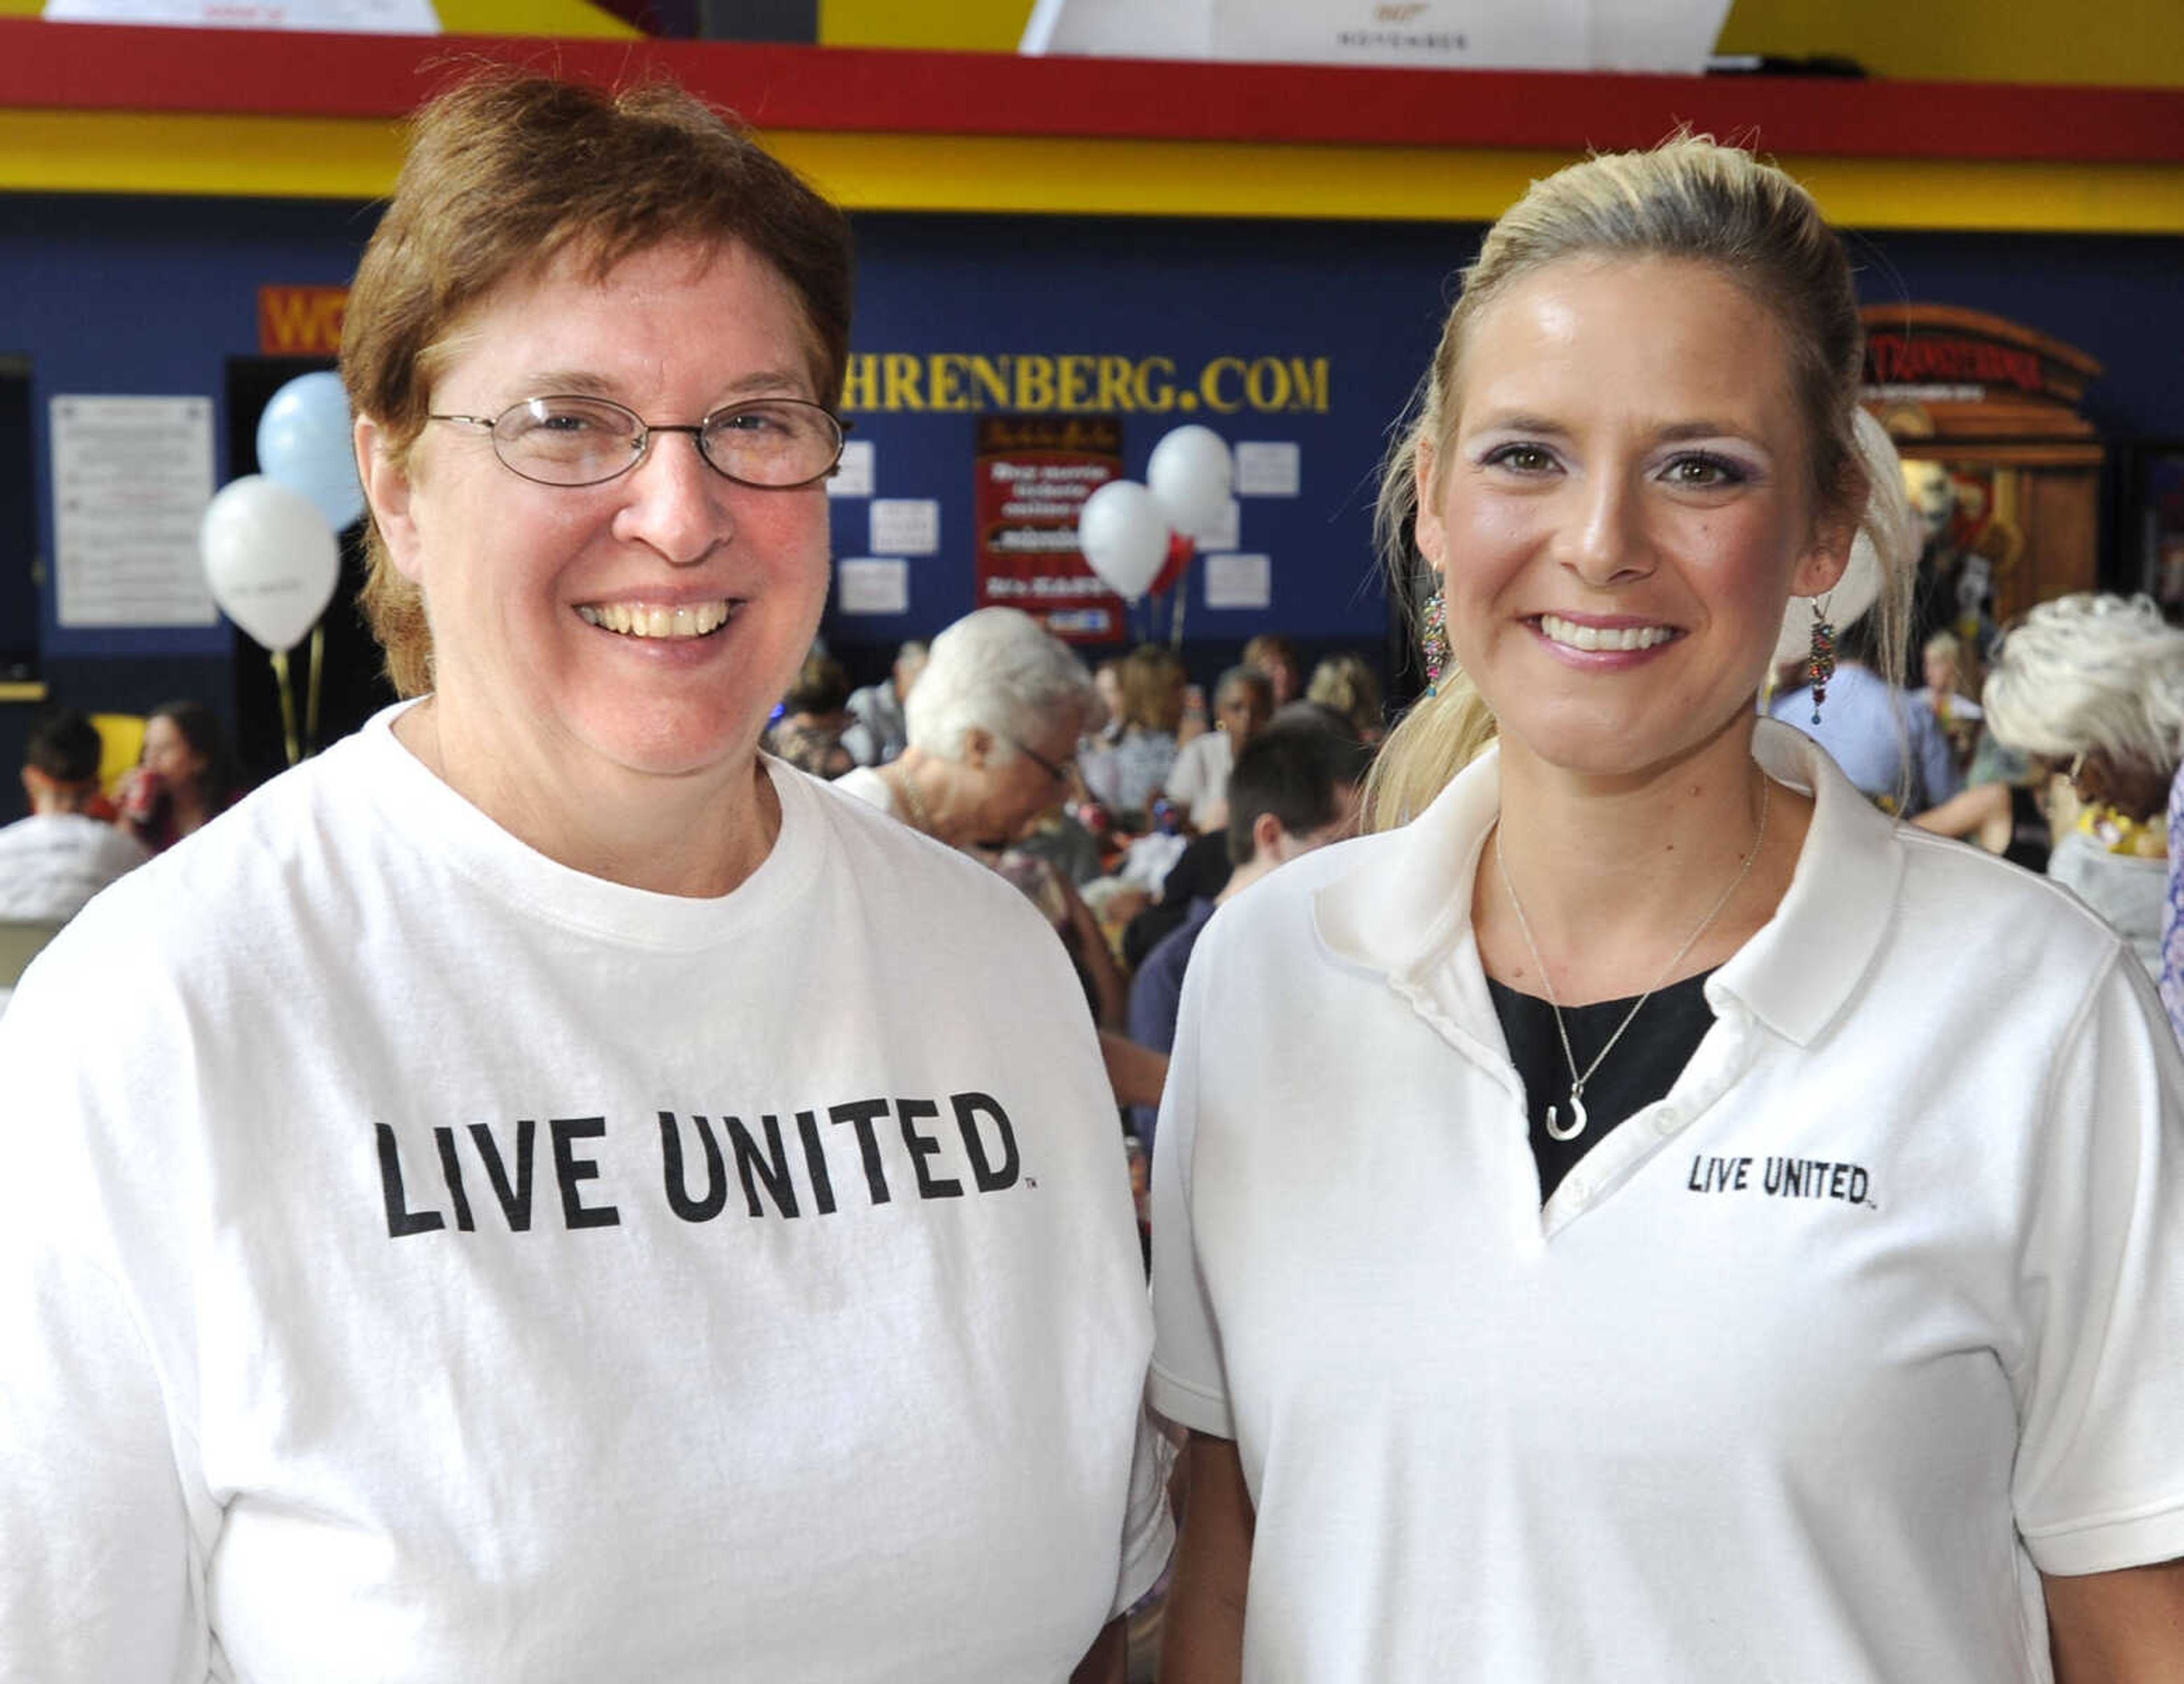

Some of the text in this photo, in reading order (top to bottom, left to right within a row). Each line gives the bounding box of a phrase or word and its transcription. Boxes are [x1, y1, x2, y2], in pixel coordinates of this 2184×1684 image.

[374, 1116, 621, 1238] LIVE
[657, 1092, 1020, 1223] UNITED
[1687, 1154, 1869, 1204] LIVE UNITED
